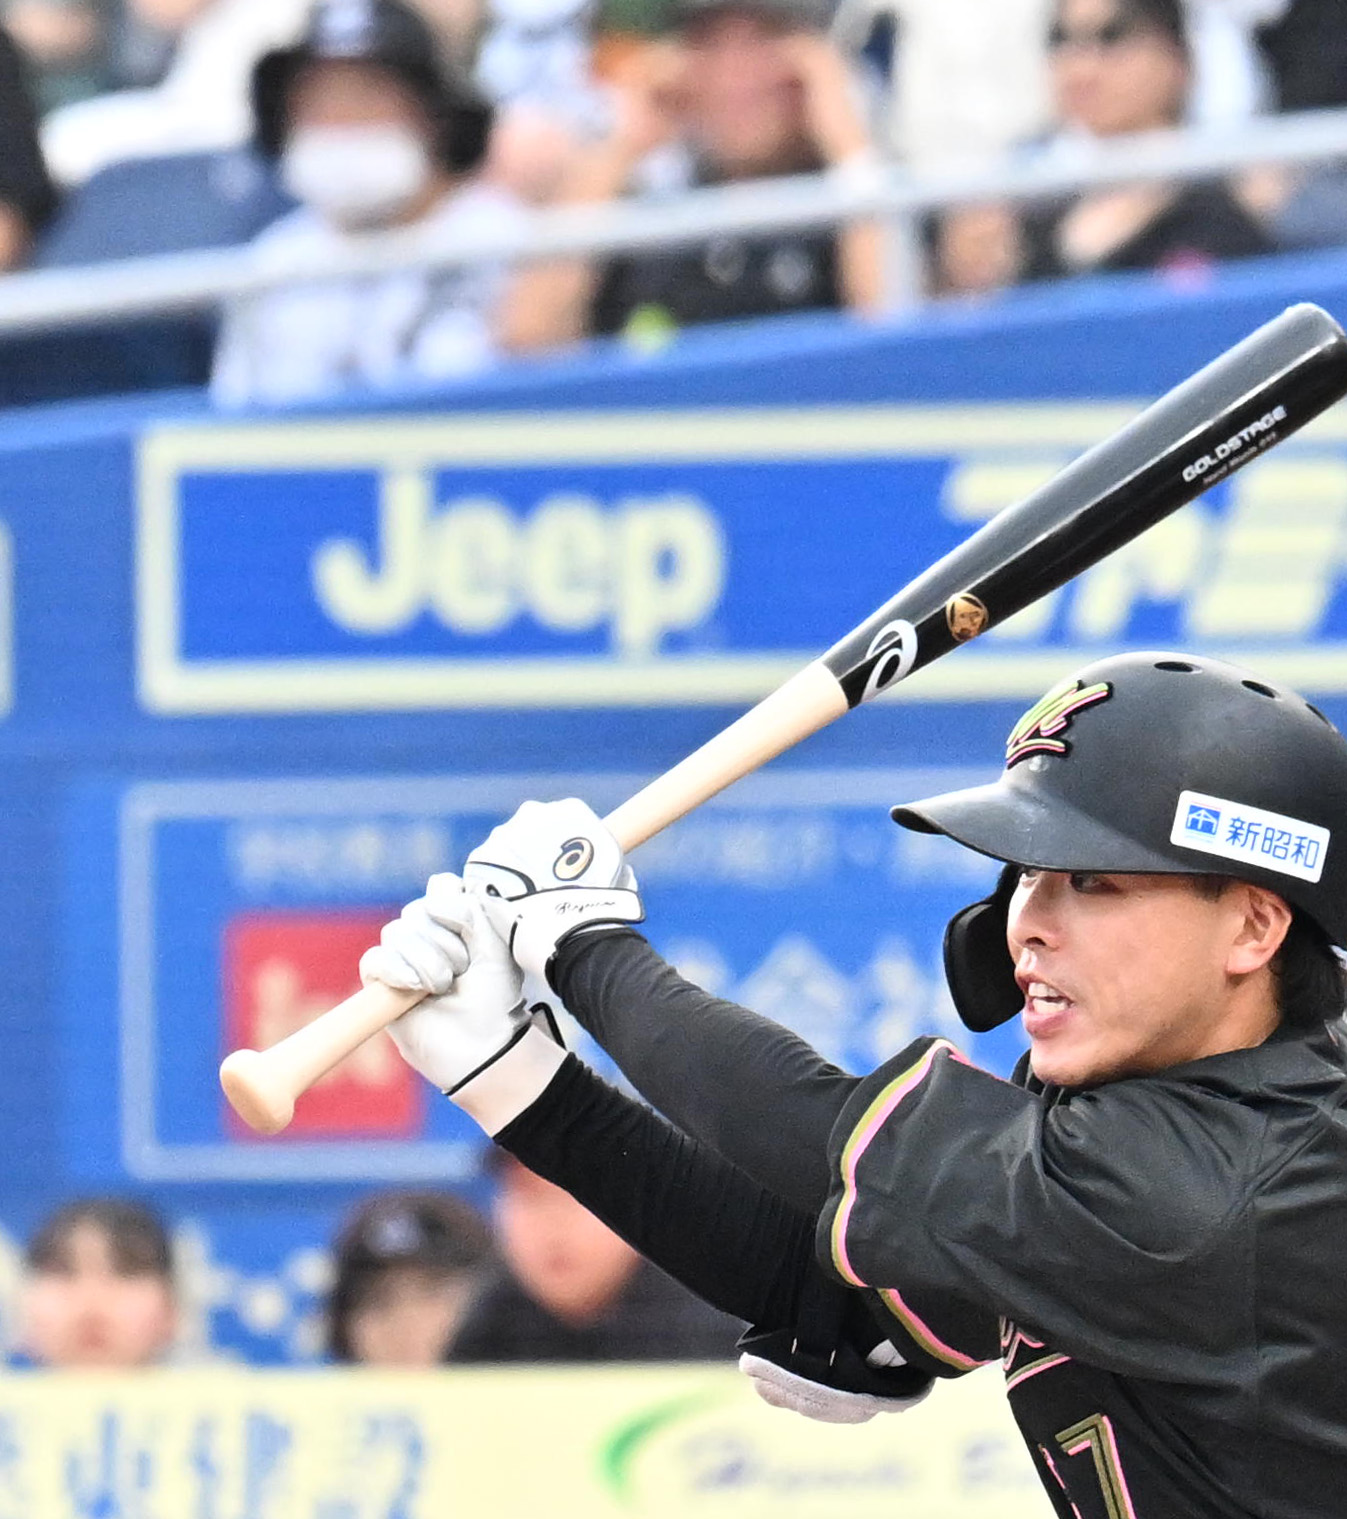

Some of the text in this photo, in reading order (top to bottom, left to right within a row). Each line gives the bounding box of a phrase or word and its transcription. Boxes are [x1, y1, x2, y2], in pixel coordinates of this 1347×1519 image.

[1182, 404, 1287, 482] GOLDSTAGE
[312, 472, 726, 655] Jeep
[1226, 816, 1320, 869] 新昭和
